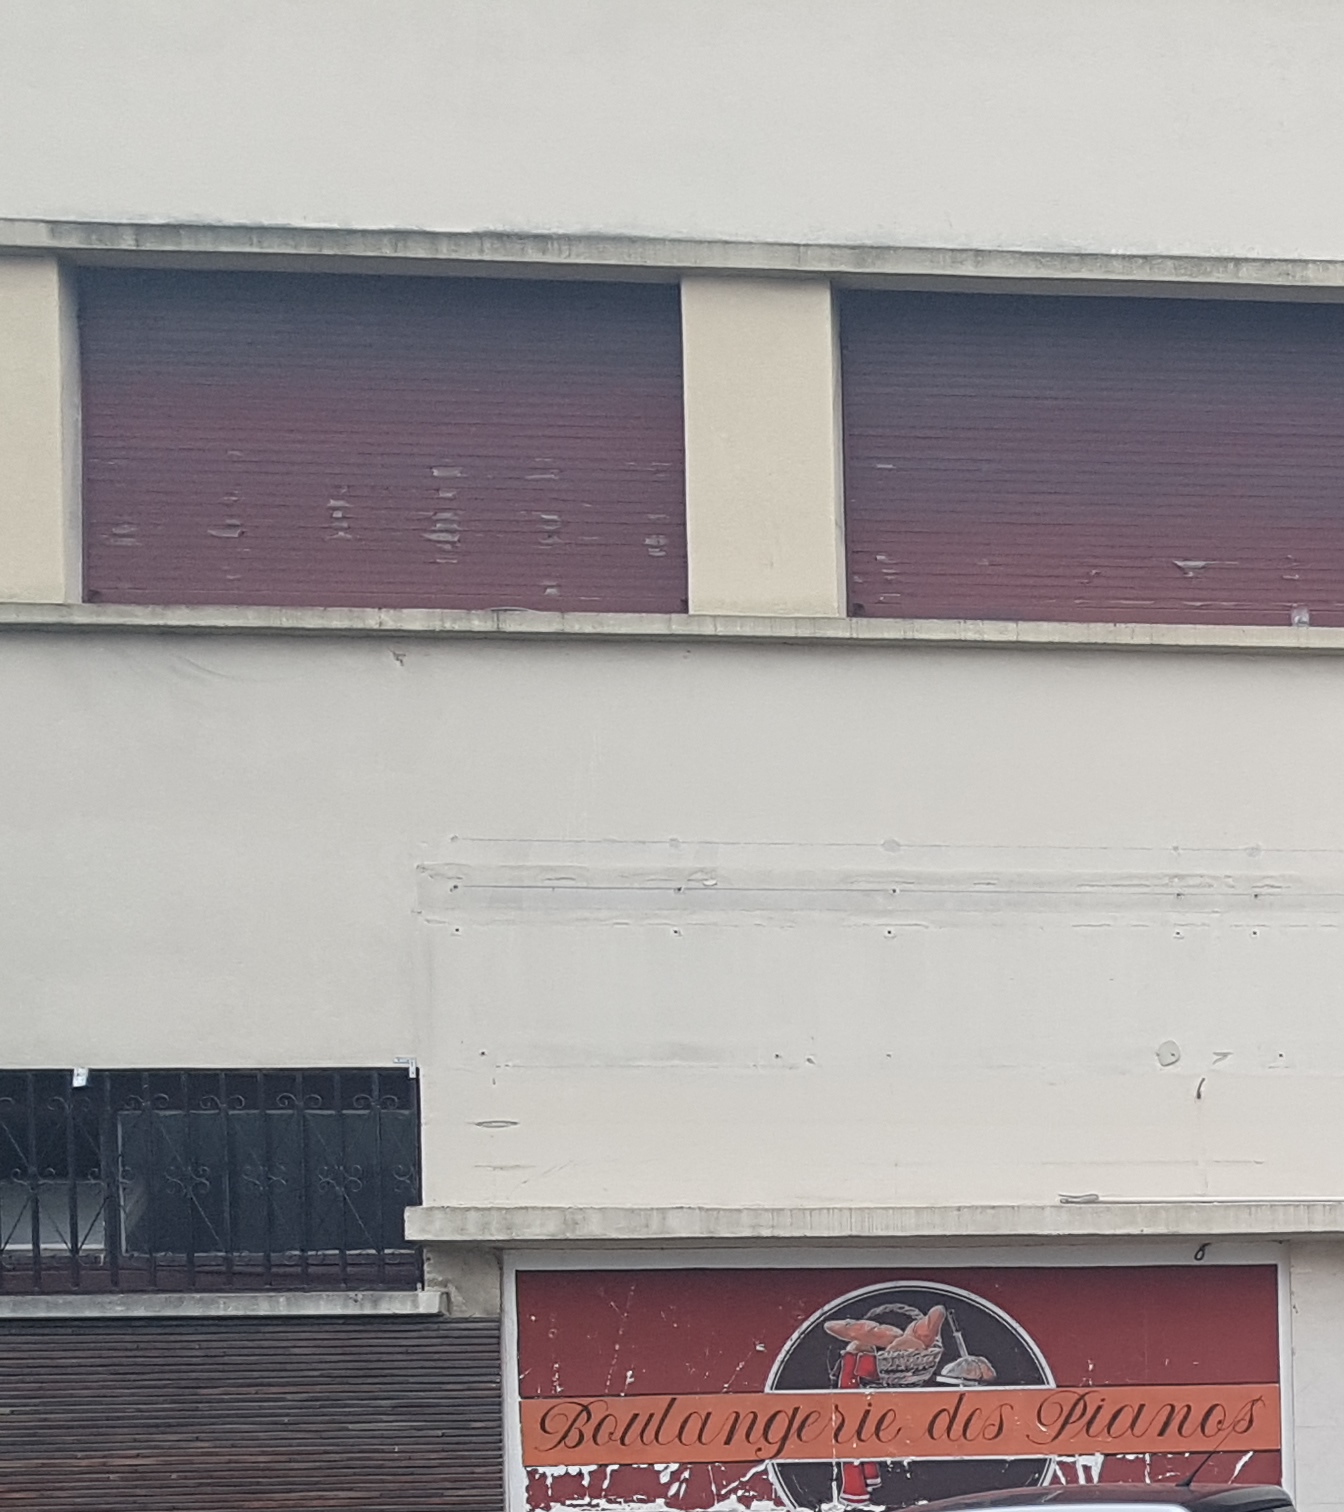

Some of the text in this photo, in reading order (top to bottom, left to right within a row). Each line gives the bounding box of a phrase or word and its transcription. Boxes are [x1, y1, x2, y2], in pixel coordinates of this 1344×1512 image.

[535, 1389, 1266, 1459] Boulangerie des Pianos
